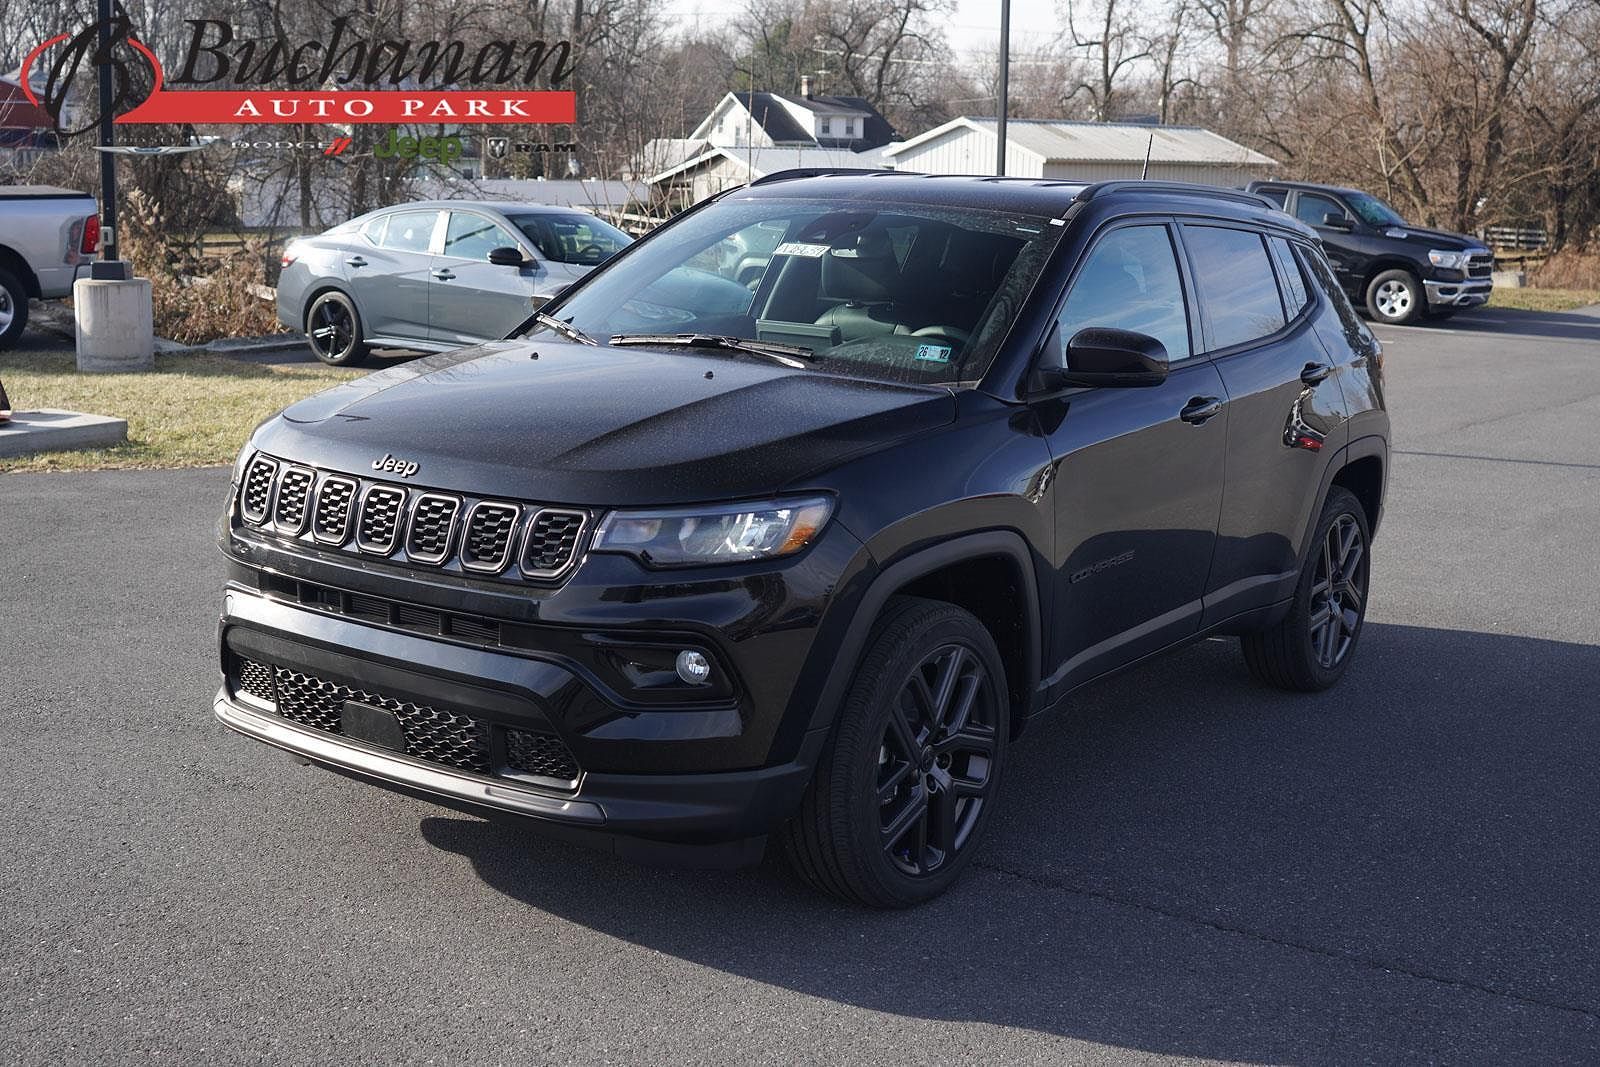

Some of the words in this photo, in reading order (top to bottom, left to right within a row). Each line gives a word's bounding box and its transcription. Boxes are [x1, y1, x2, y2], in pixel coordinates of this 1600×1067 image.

[919, 345, 929, 357] 26
[939, 348, 949, 360] 12
[371, 453, 420, 478] Jeep
